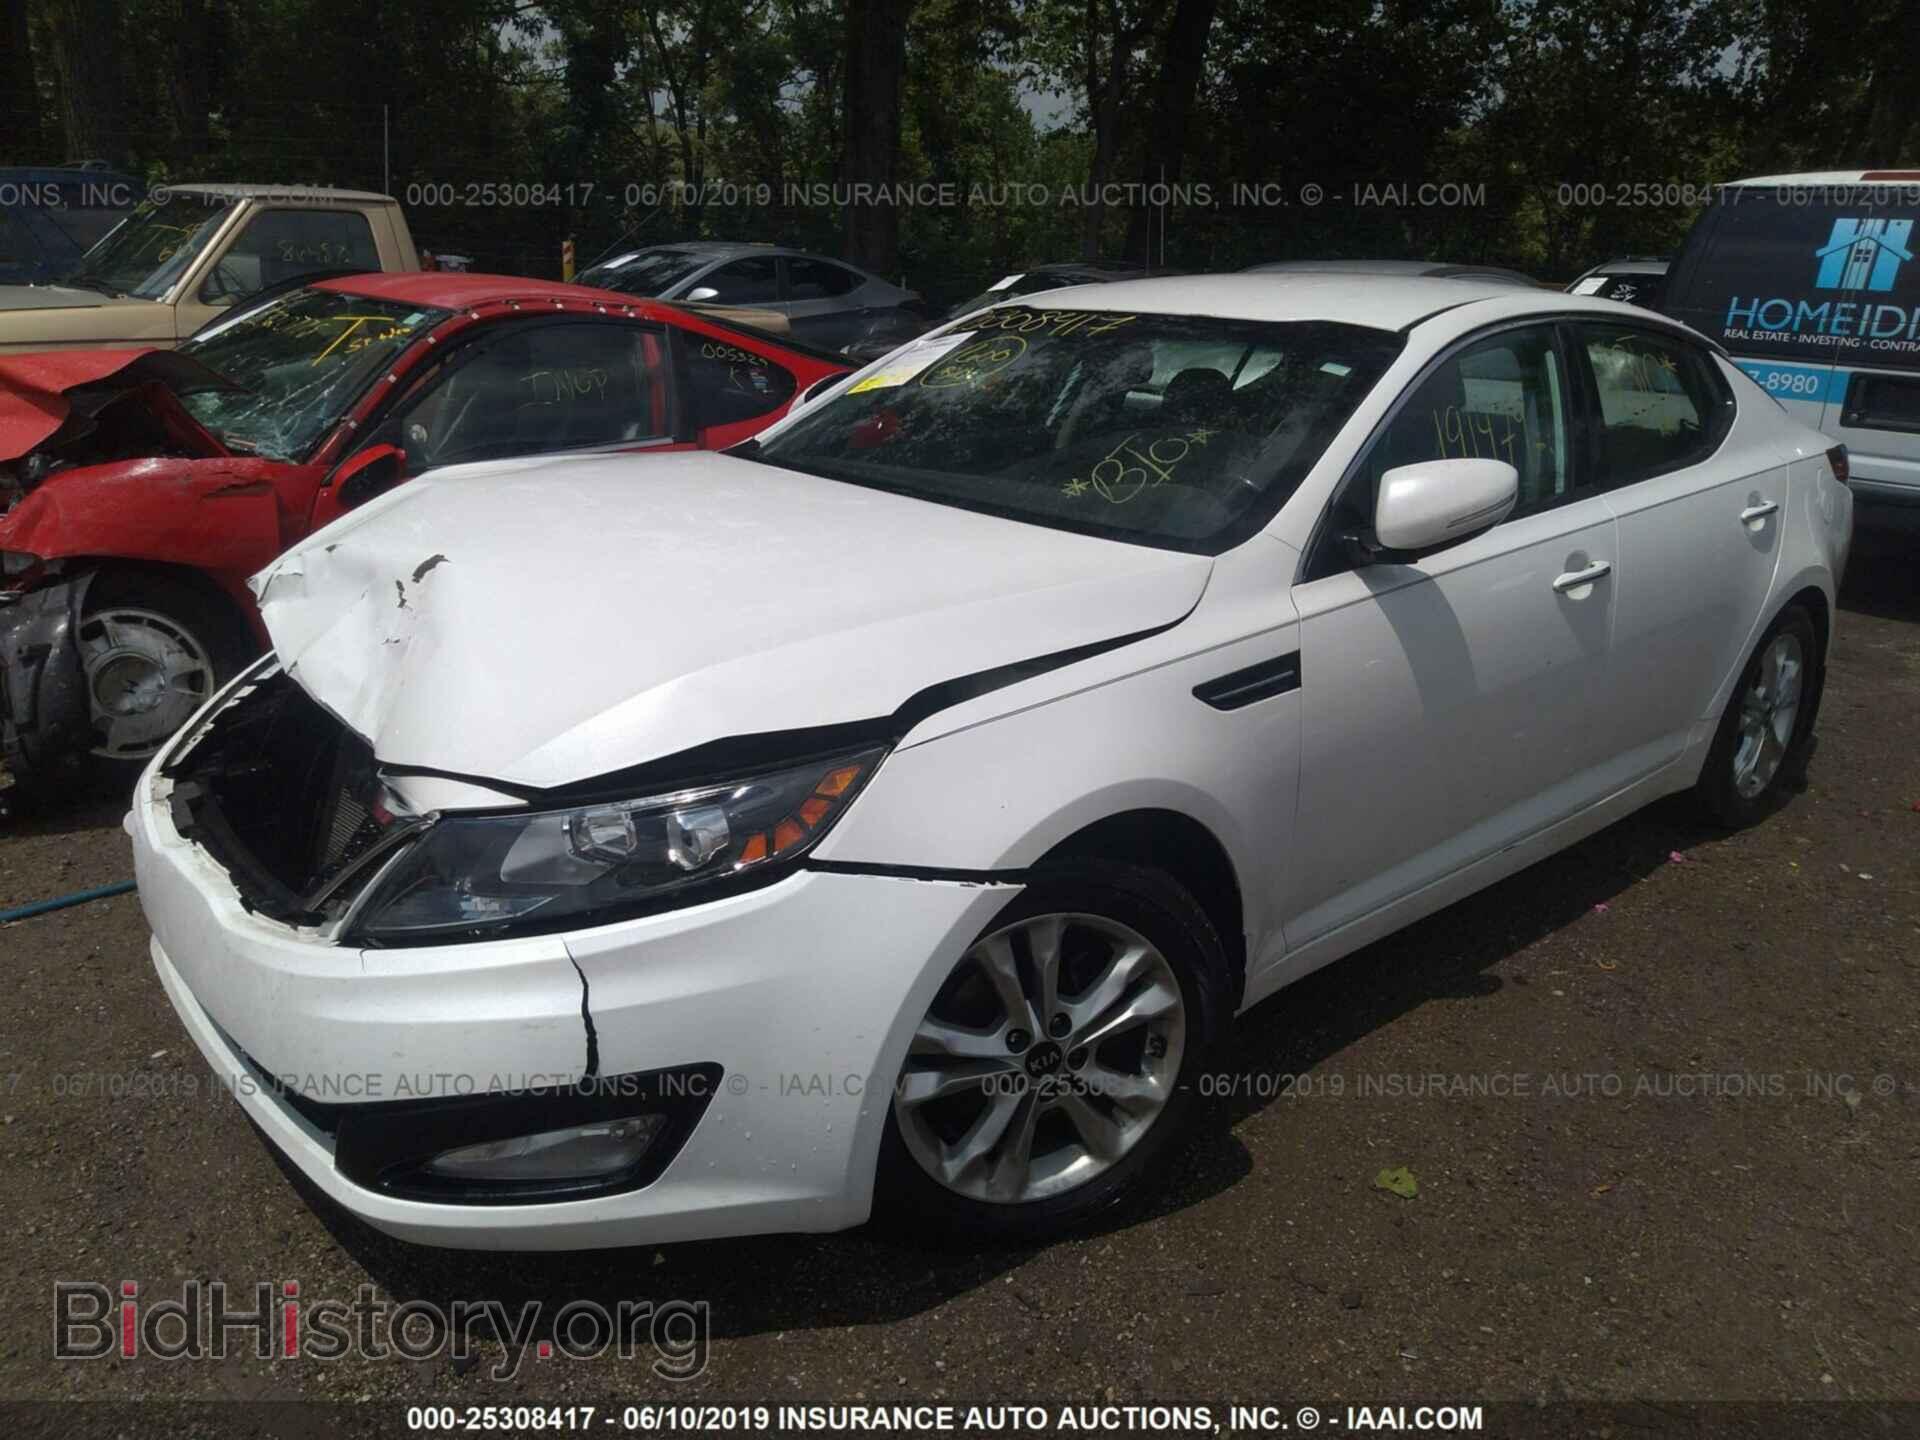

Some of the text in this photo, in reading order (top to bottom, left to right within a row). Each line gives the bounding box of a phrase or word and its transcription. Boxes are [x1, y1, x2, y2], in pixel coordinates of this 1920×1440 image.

[1723, 328, 1750, 340] REAL
[1752, 330, 1791, 343] ESTATE
[1798, 334, 1861, 348] INVESTING
[1030, 1050, 1060, 1072] KIA
